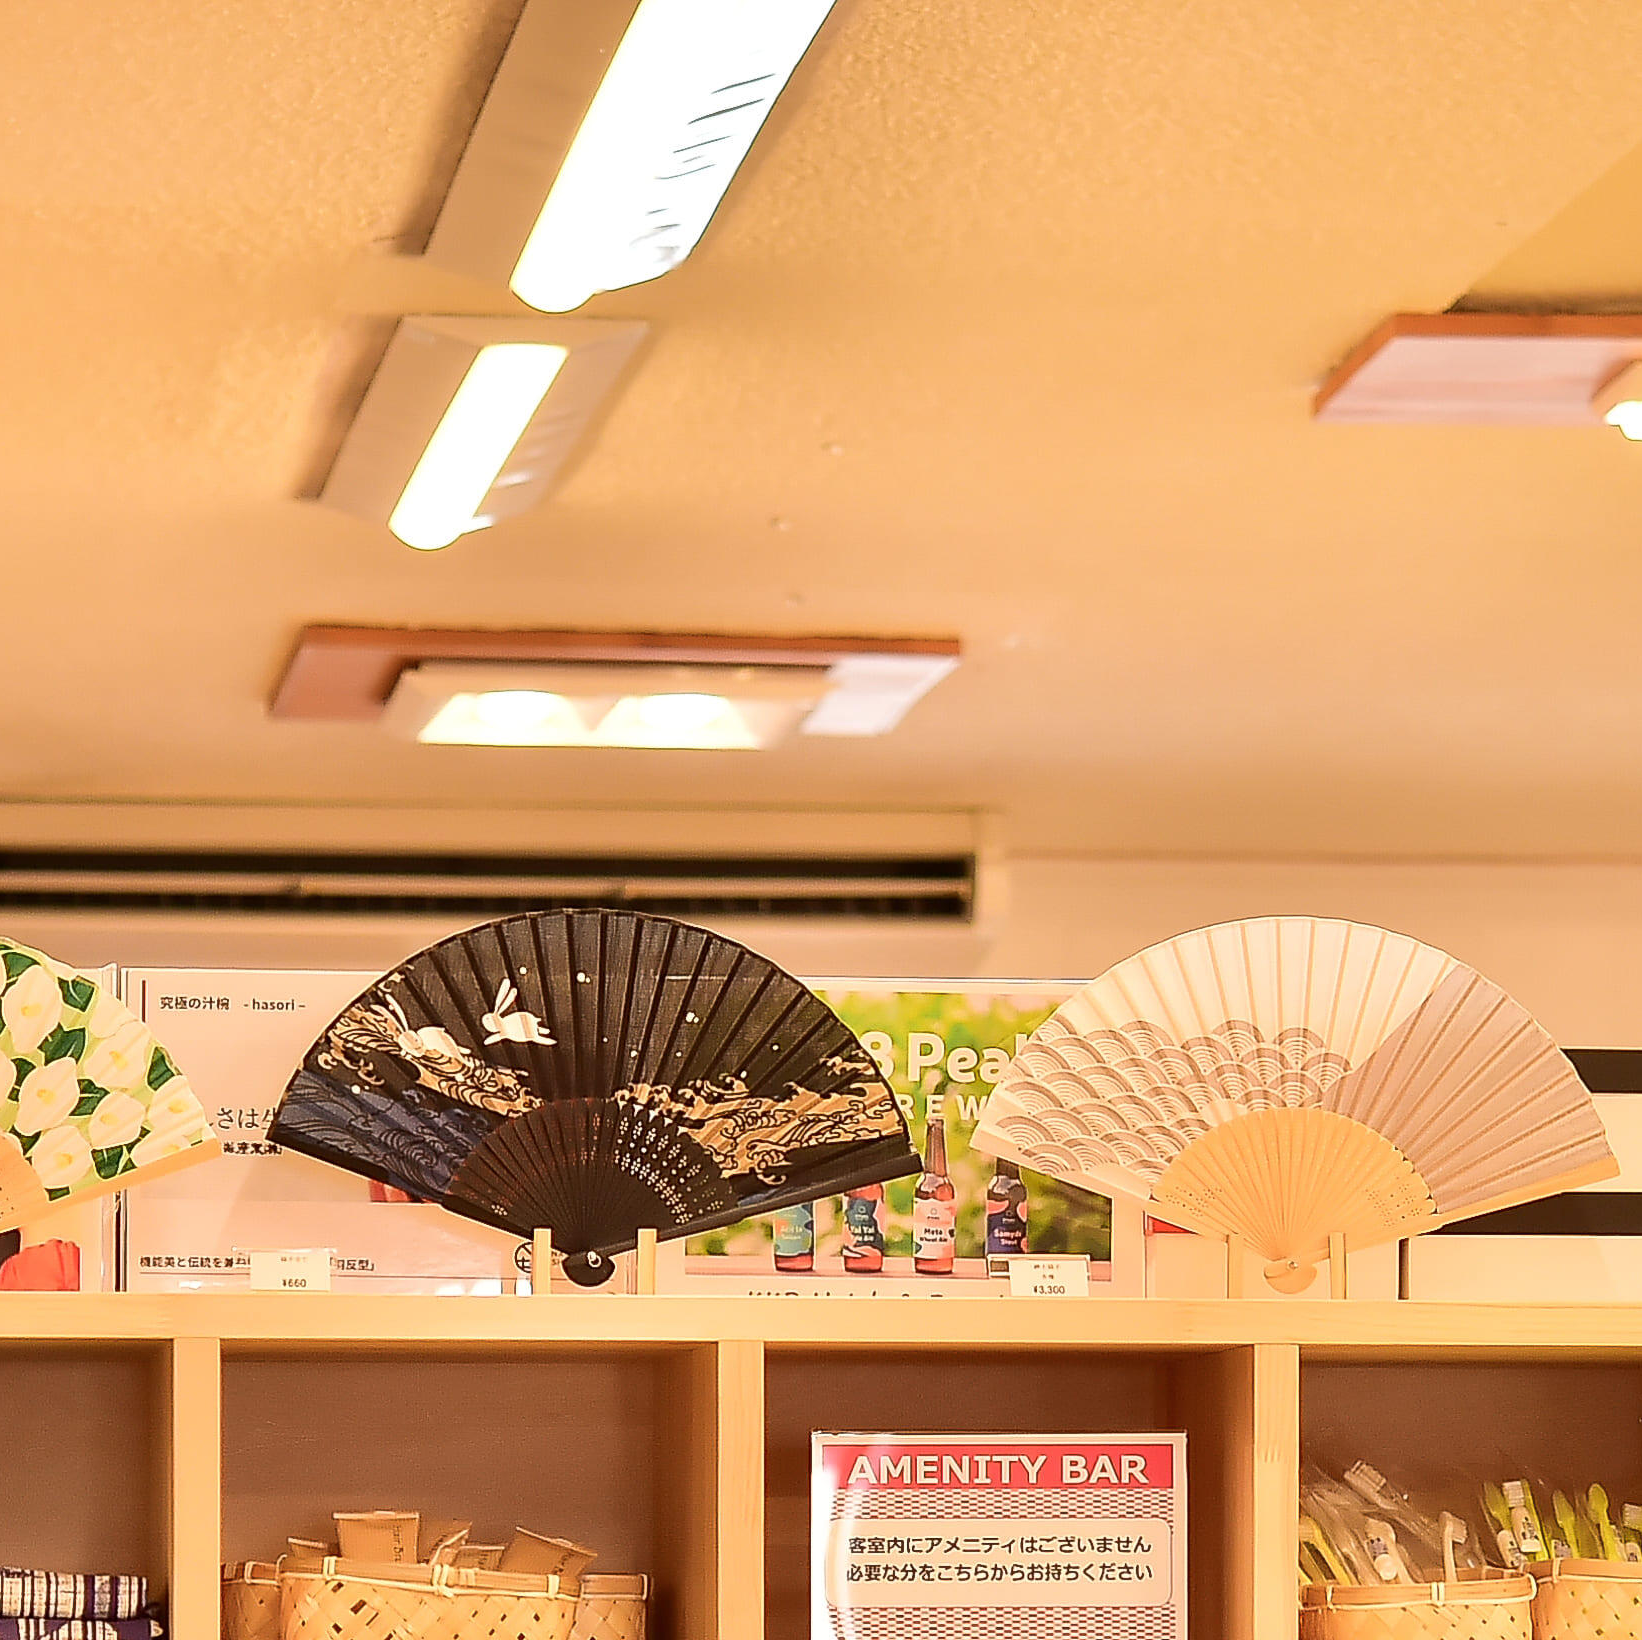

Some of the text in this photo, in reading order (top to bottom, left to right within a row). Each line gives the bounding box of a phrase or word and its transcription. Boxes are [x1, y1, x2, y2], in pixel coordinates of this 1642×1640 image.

[846, 1454, 1150, 1485] AMENITY BAR
[848, 1536, 1152, 1554] 客室内にアメニティはございません
[846, 1563, 1153, 1582] 必要な分をこちらからお持ちください
